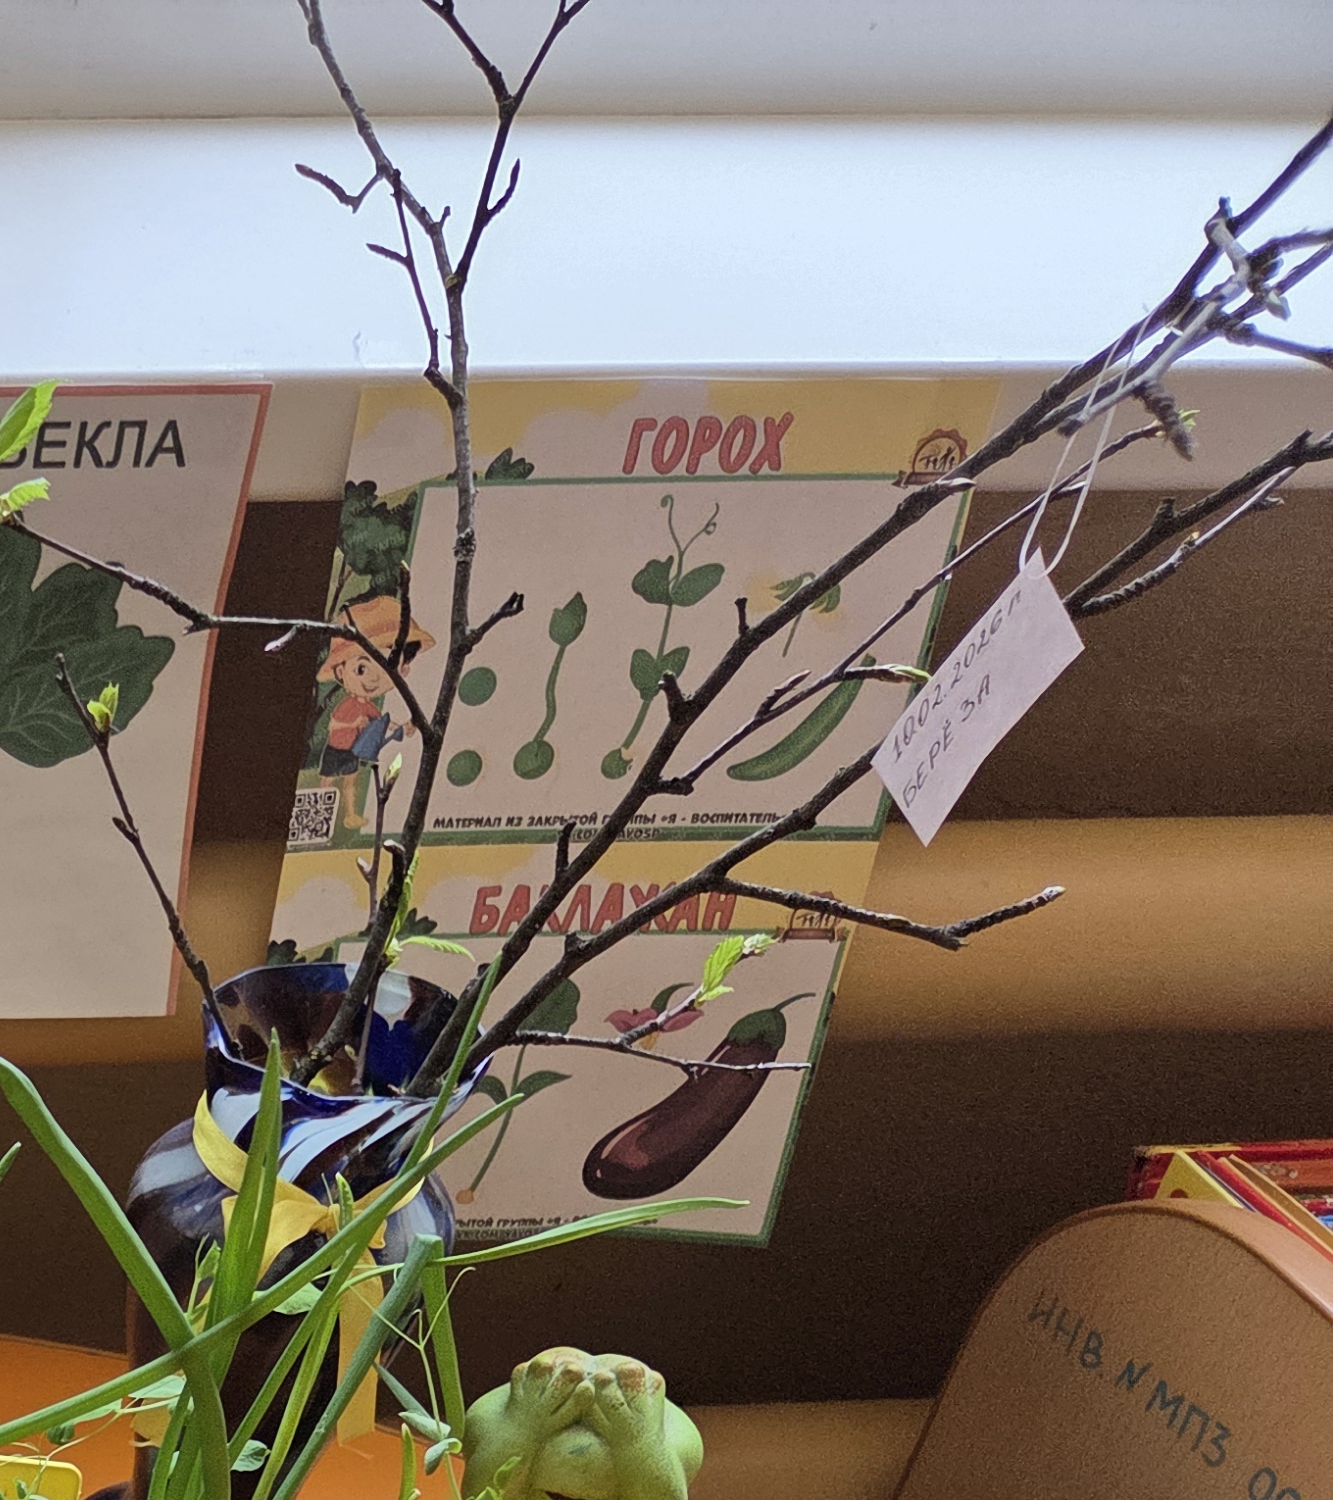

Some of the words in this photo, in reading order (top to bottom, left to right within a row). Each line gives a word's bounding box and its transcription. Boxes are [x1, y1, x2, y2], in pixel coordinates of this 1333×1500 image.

[621, 411, 795, 476] ГОРОХ
[432, 814, 503, 830] МАТЕРИАЛ
[505, 815, 524, 828] ИЗ
